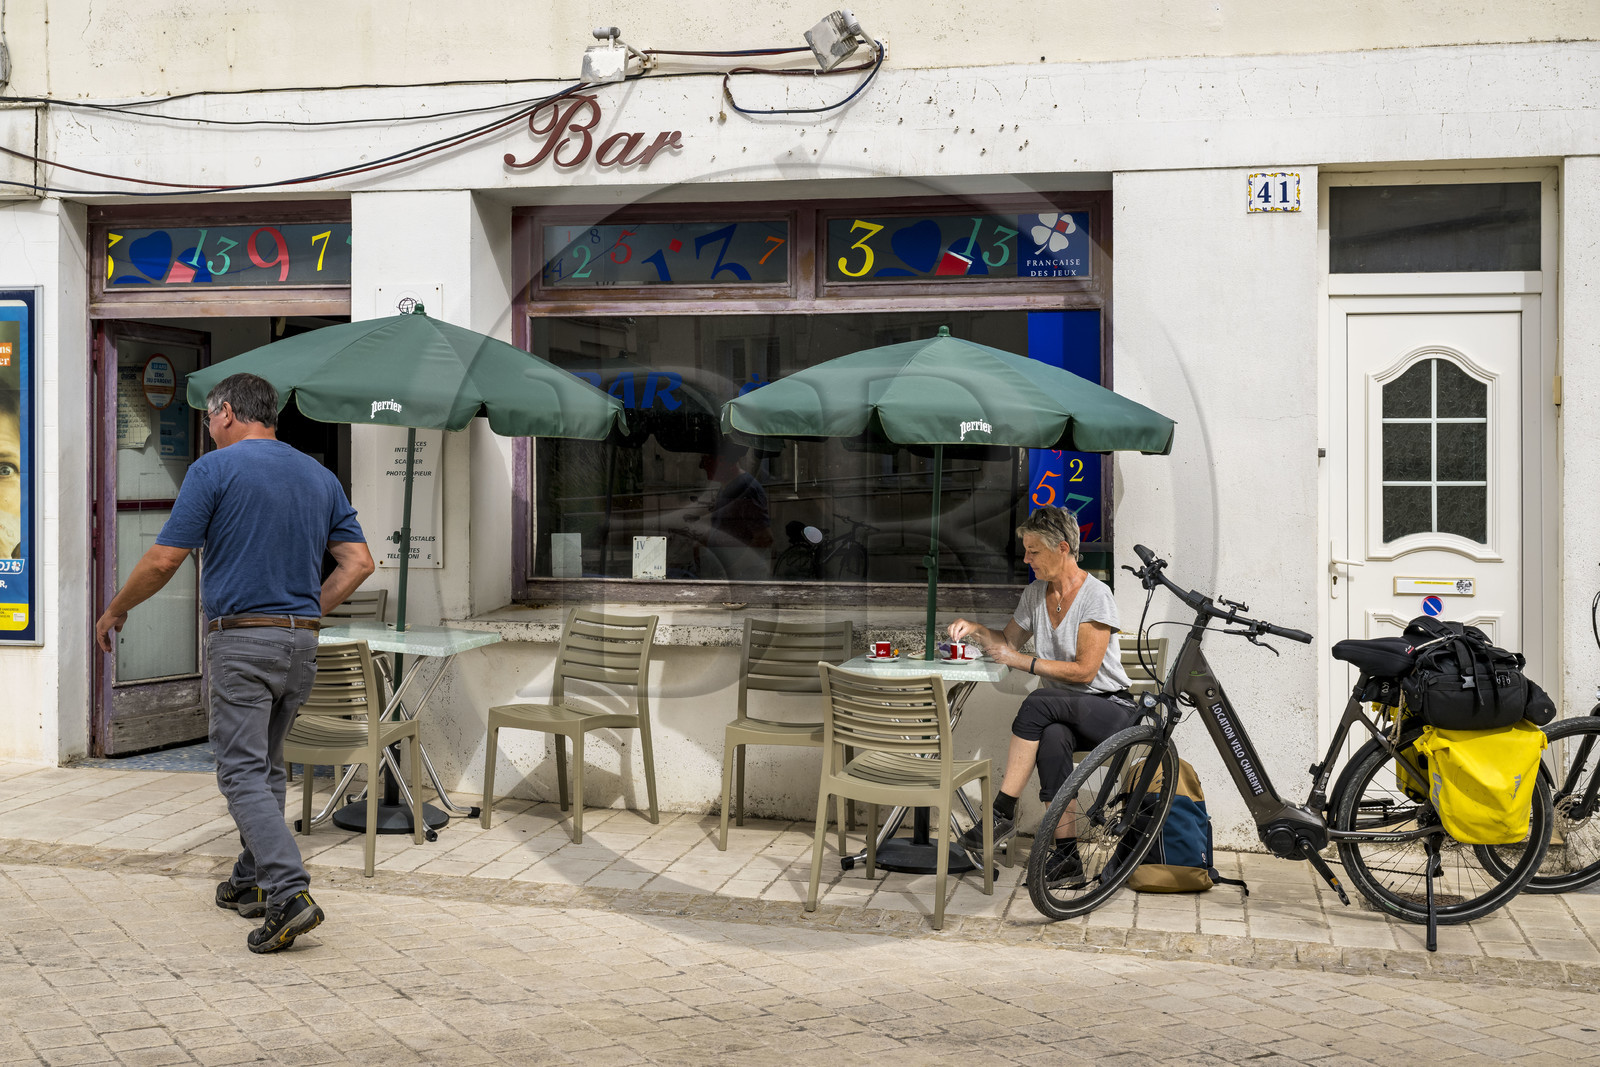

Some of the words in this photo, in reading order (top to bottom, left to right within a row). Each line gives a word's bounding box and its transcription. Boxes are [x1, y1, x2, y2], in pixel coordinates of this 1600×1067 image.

[503, 94, 684, 168] Bar
[1257, 181, 1290, 204] 41
[247, 226, 290, 282] 9
[311, 230, 332, 271] 7
[590, 228, 601, 244] 8
[610, 229, 637, 265] 5
[758, 236, 786, 265] 7
[837, 219, 884, 277] 3
[571, 245, 593, 278] 2
[1053, 269, 1077, 277] JEUX
[1032, 470, 1061, 507] 5
[1069, 459, 1084, 482] 2
[1211, 703, 1235, 740] LOCATION
[1230, 738, 1245, 759] VELO
[1240, 758, 1264, 795] CHARENTE
